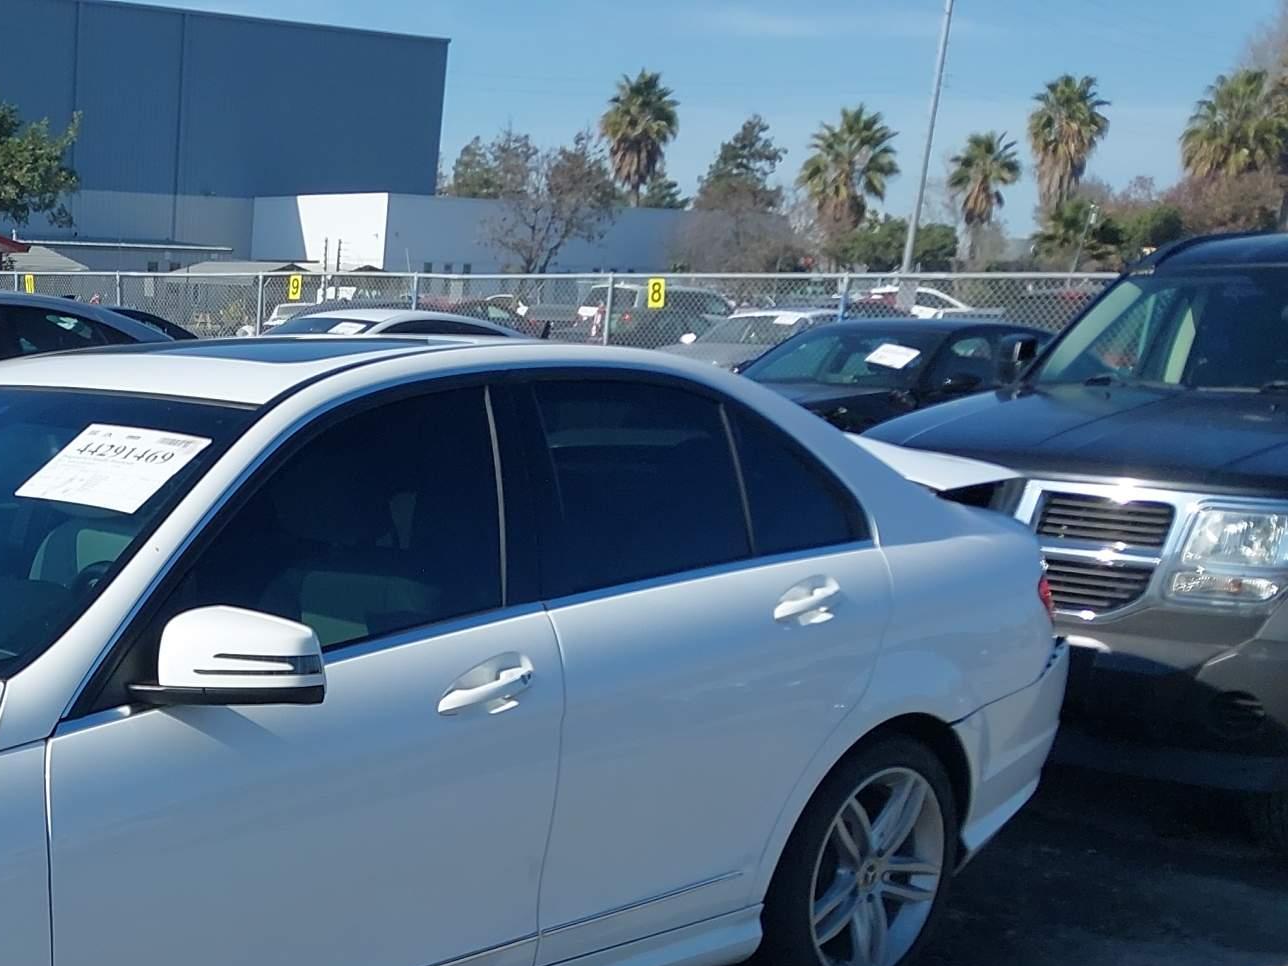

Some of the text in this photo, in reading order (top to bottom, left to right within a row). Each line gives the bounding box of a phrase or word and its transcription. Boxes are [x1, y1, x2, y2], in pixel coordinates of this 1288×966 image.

[292, 278, 299, 295] 9
[651, 282, 661, 303] 8
[77, 442, 175, 464] 44291469
